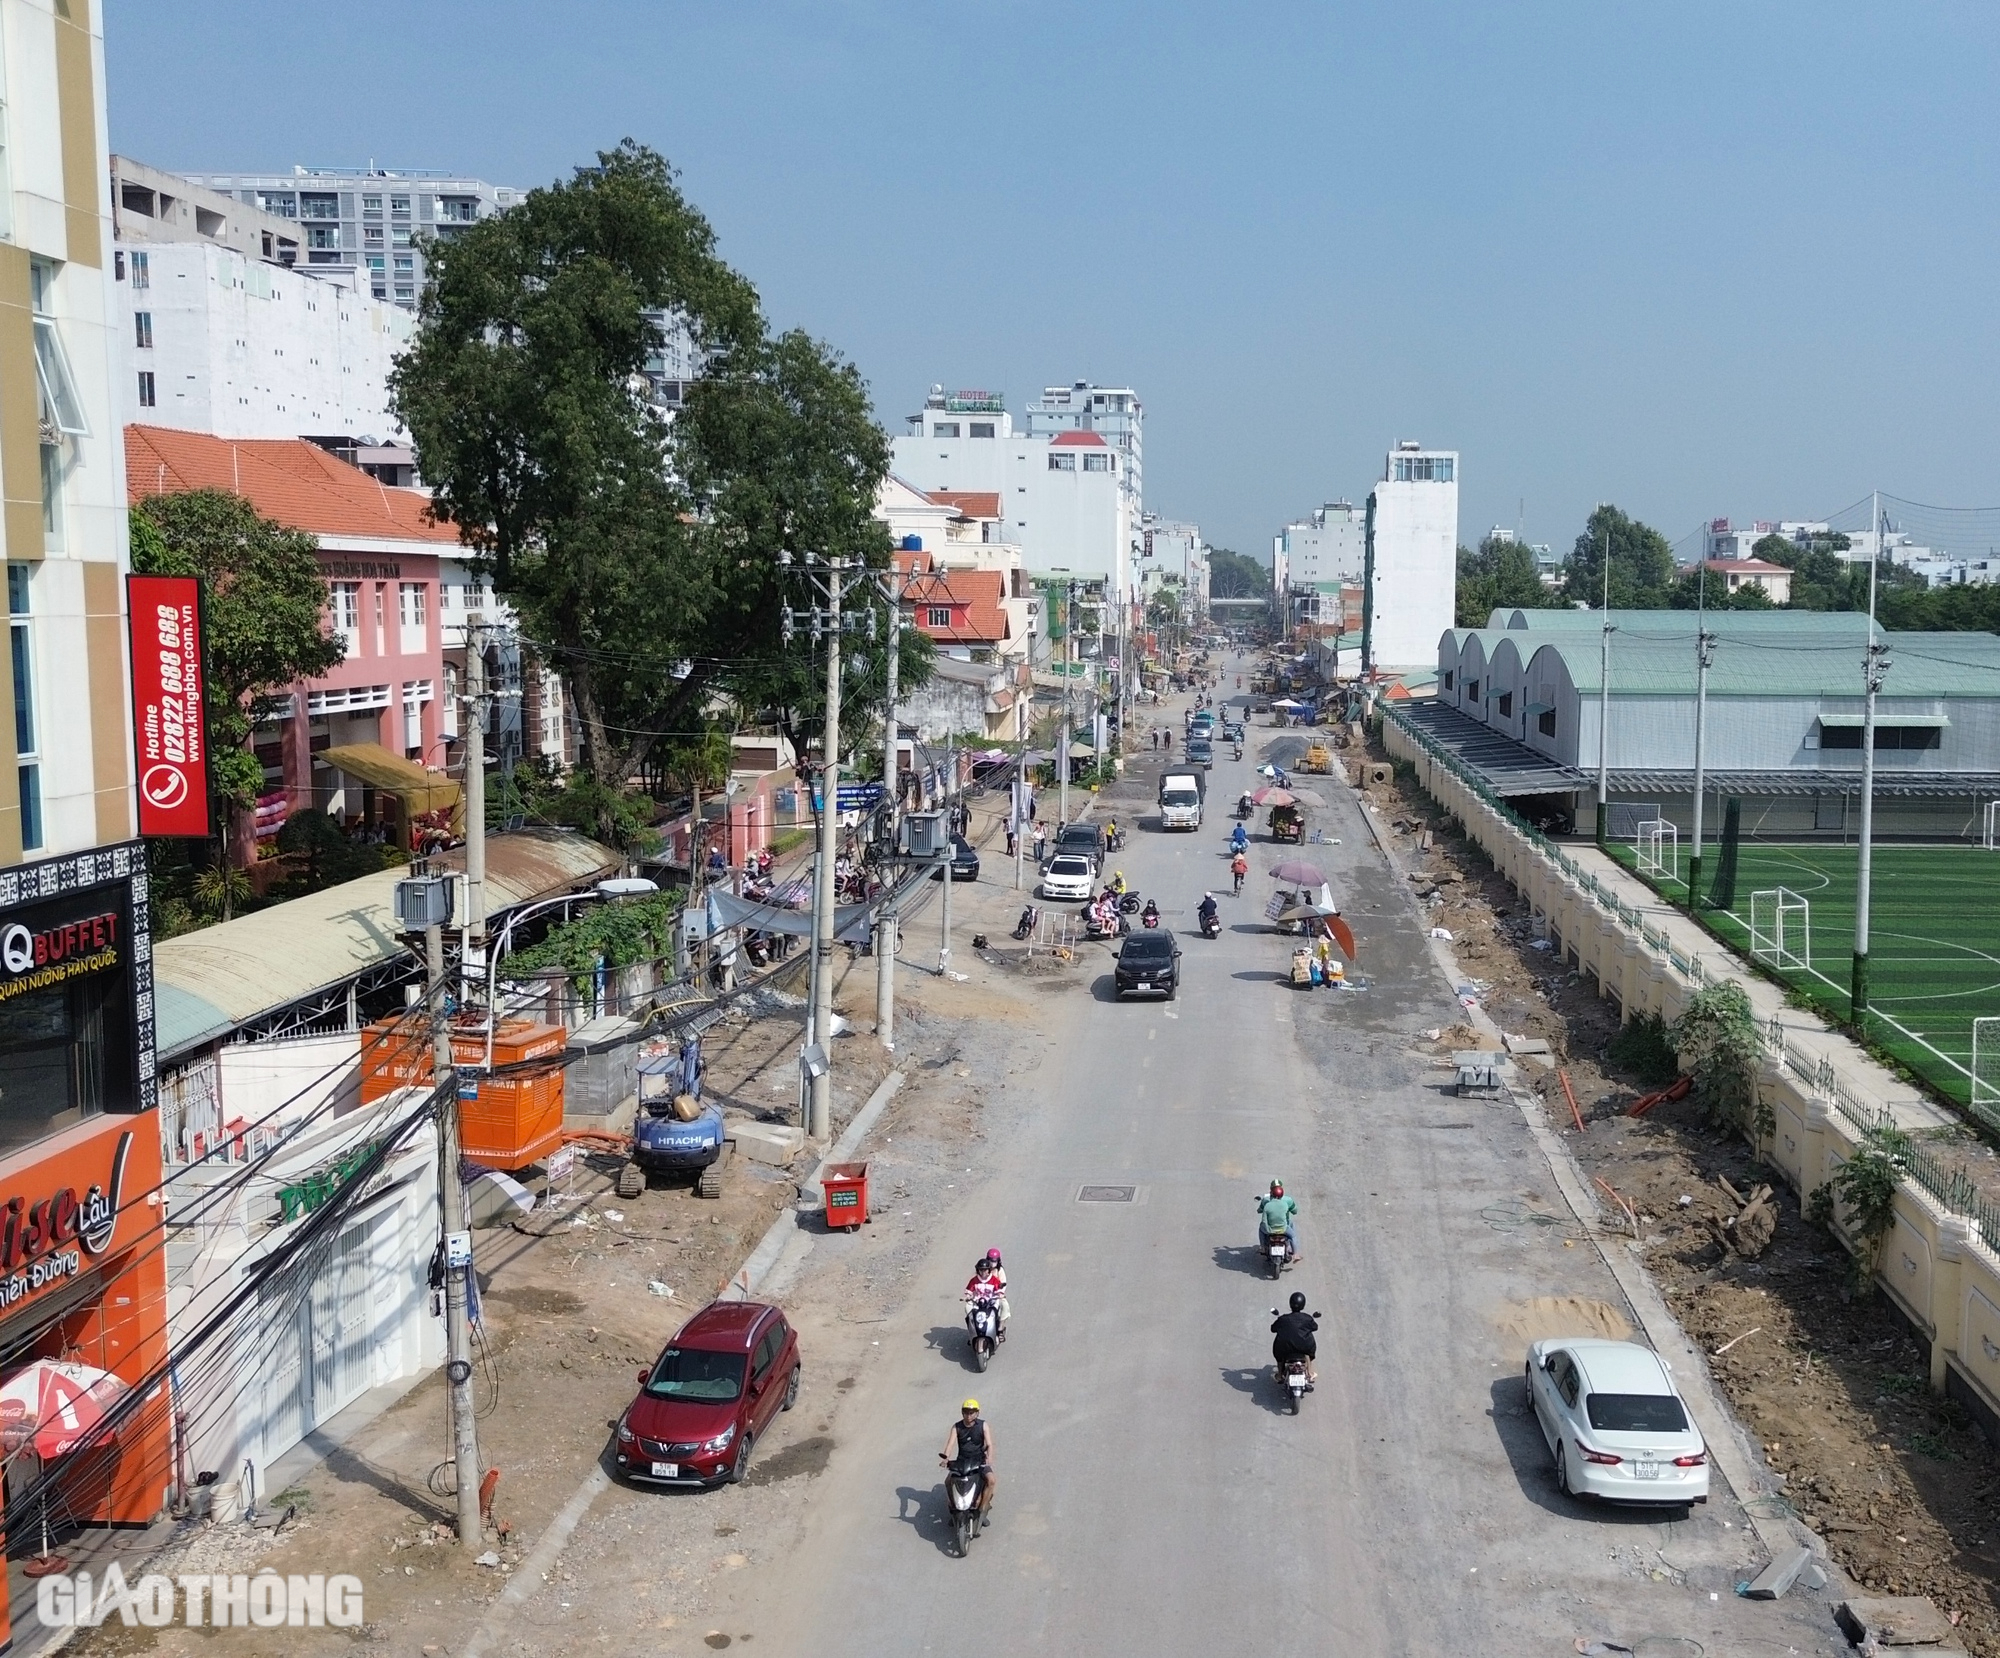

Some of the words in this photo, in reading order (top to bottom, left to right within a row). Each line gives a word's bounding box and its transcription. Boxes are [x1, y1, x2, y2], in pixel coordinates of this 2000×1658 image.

[959, 390, 988, 400] HOTEL
[1144, 531, 1152, 557] HOTEL
[157, 604, 181, 649] 688
[159, 650, 182, 694] 688
[181, 604, 200, 763] www.kingbbq.com.vn
[144, 704, 160, 760] Hotline
[162, 695, 186, 764] 02822
[0, 924, 34, 973] Q
[34, 912, 117, 965] BUFFET
[79, 1185, 109, 1231] Lẩu
[33, 1251, 79, 1288] Đường
